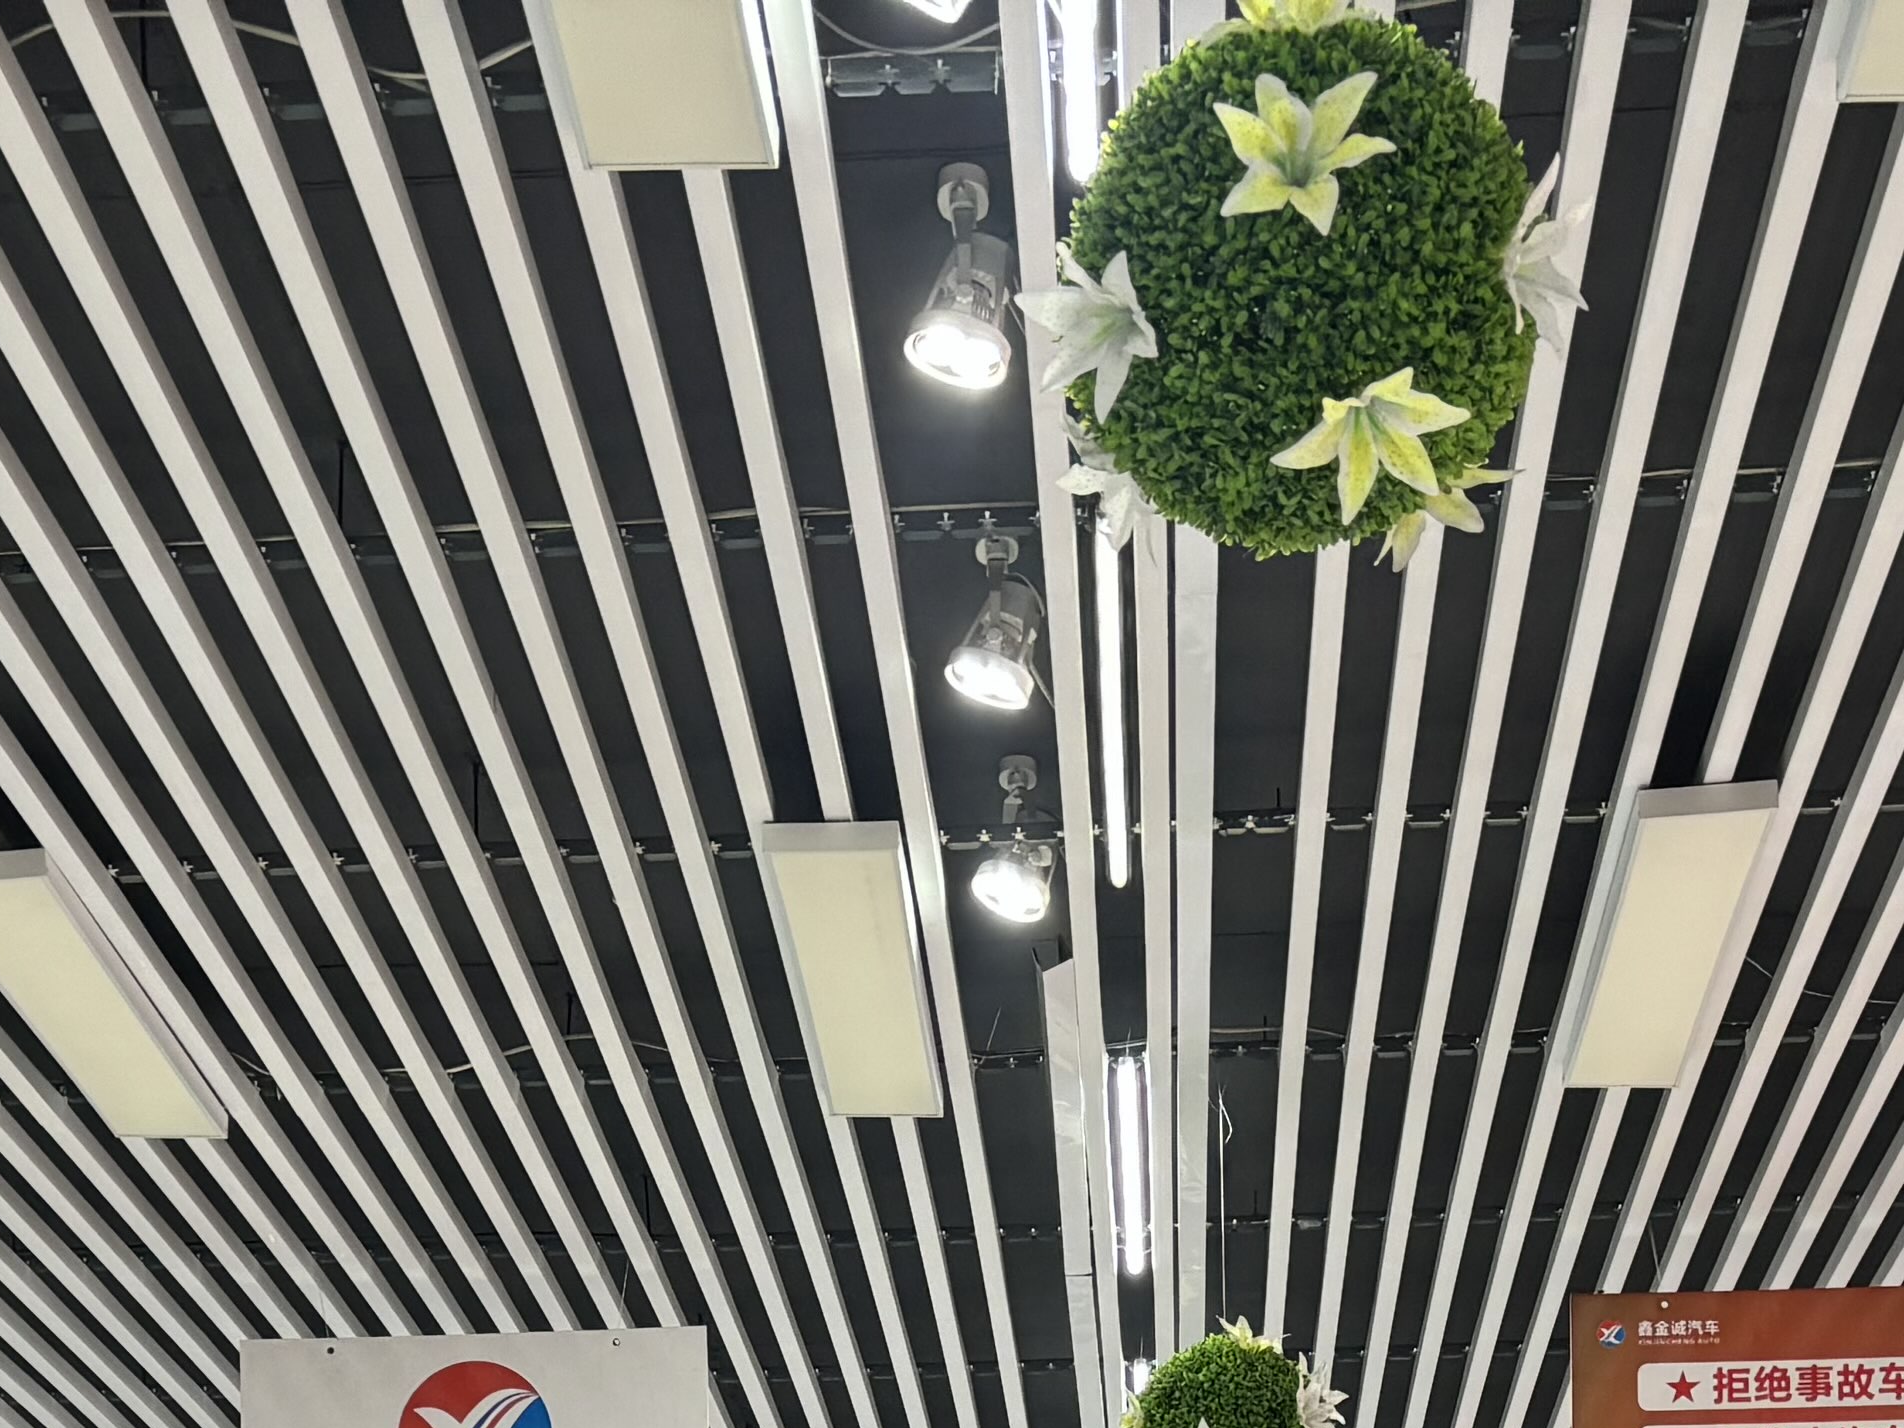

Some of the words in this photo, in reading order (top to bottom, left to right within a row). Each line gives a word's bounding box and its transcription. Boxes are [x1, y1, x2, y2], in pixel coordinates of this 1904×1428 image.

[1638, 1319, 1720, 1338] 鑫金诚汽车
